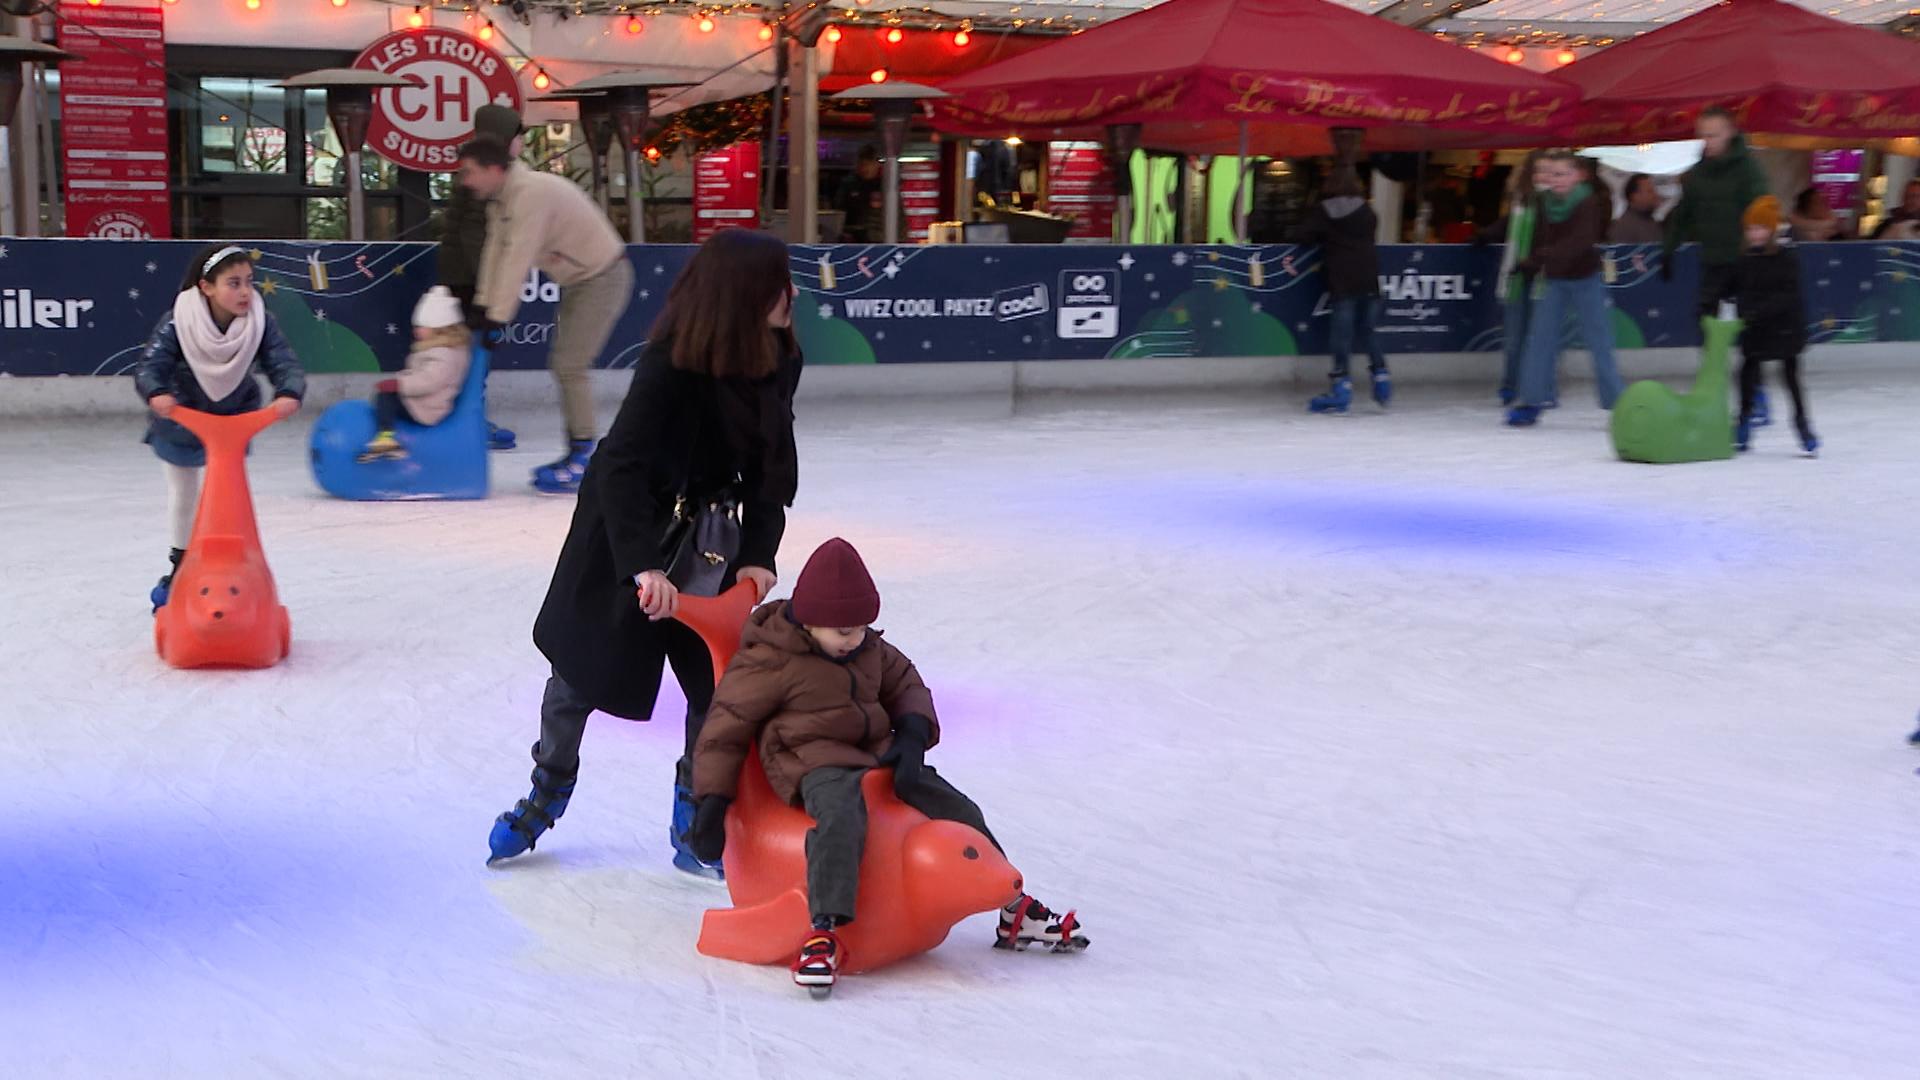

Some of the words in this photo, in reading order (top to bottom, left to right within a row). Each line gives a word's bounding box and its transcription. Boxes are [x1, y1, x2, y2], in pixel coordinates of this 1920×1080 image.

[369, 37, 418, 72] LES
[423, 35, 498, 77] TROIS
[391, 72, 470, 122] CH
[383, 130, 459, 165] SUISS
[844, 299, 892, 318] VIVEZ
[892, 299, 942, 318] COOL
[943, 298, 995, 317] PAYEZ
[998, 286, 1048, 315] cool
[1376, 268, 1473, 300] HÂTEL
[0, 288, 94, 328] iler
